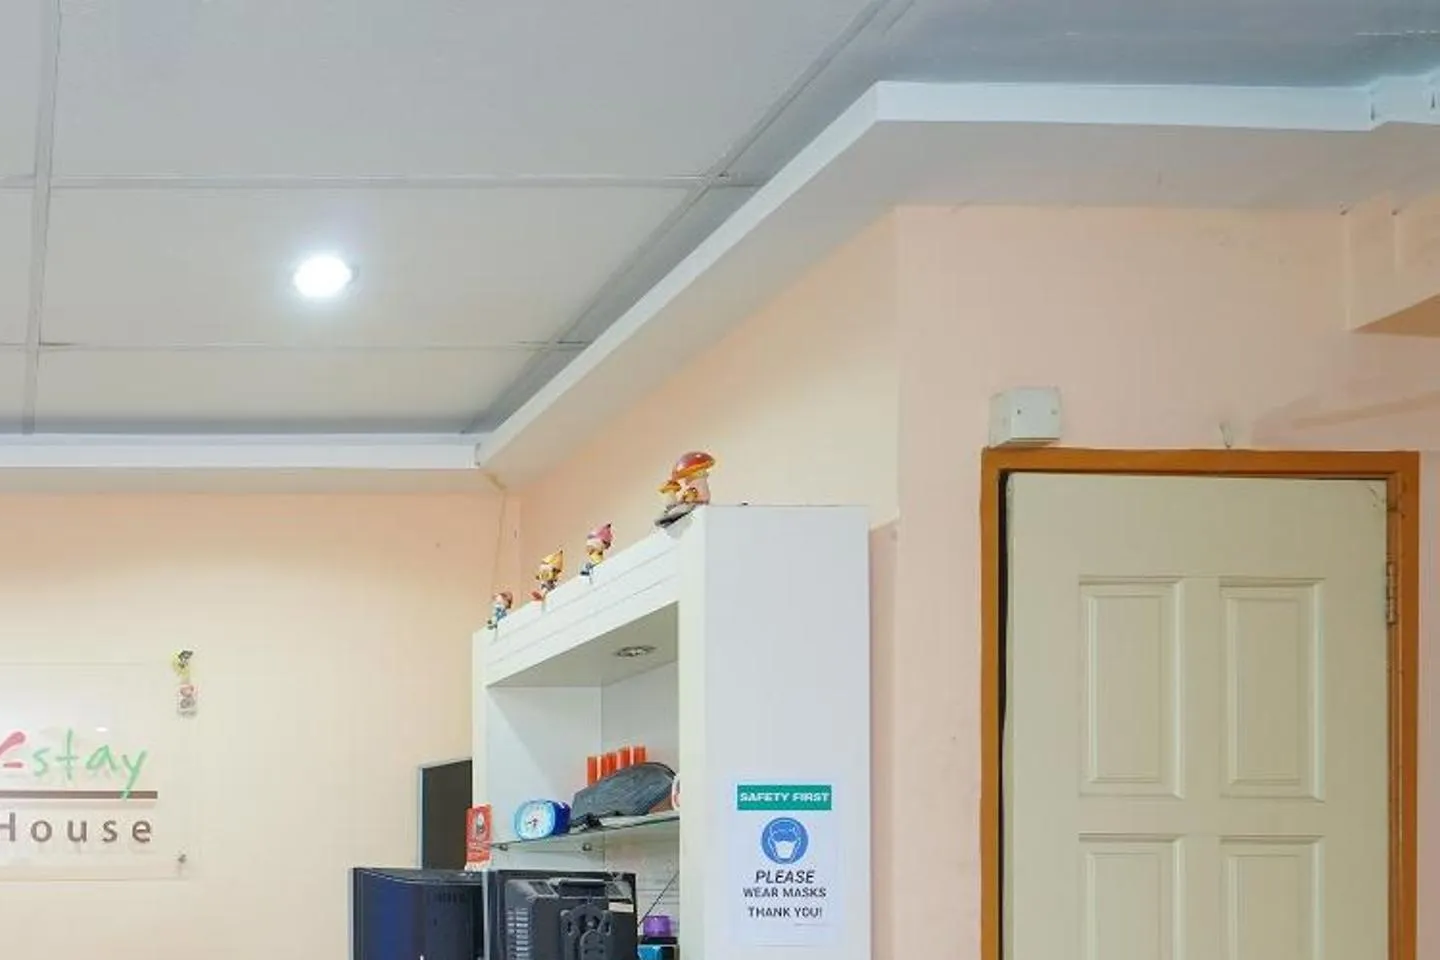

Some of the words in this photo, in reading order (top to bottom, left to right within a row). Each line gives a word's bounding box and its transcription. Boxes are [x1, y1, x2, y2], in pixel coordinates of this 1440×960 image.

[740, 792, 790, 802] SAFETY
[792, 792, 830, 802] FIRST
[755, 870, 816, 884] PLEASE
[743, 887, 779, 898] WEAR
[782, 887, 827, 898] MASKS
[748, 907, 791, 918] THANK
[794, 907, 822, 918] YOU!
